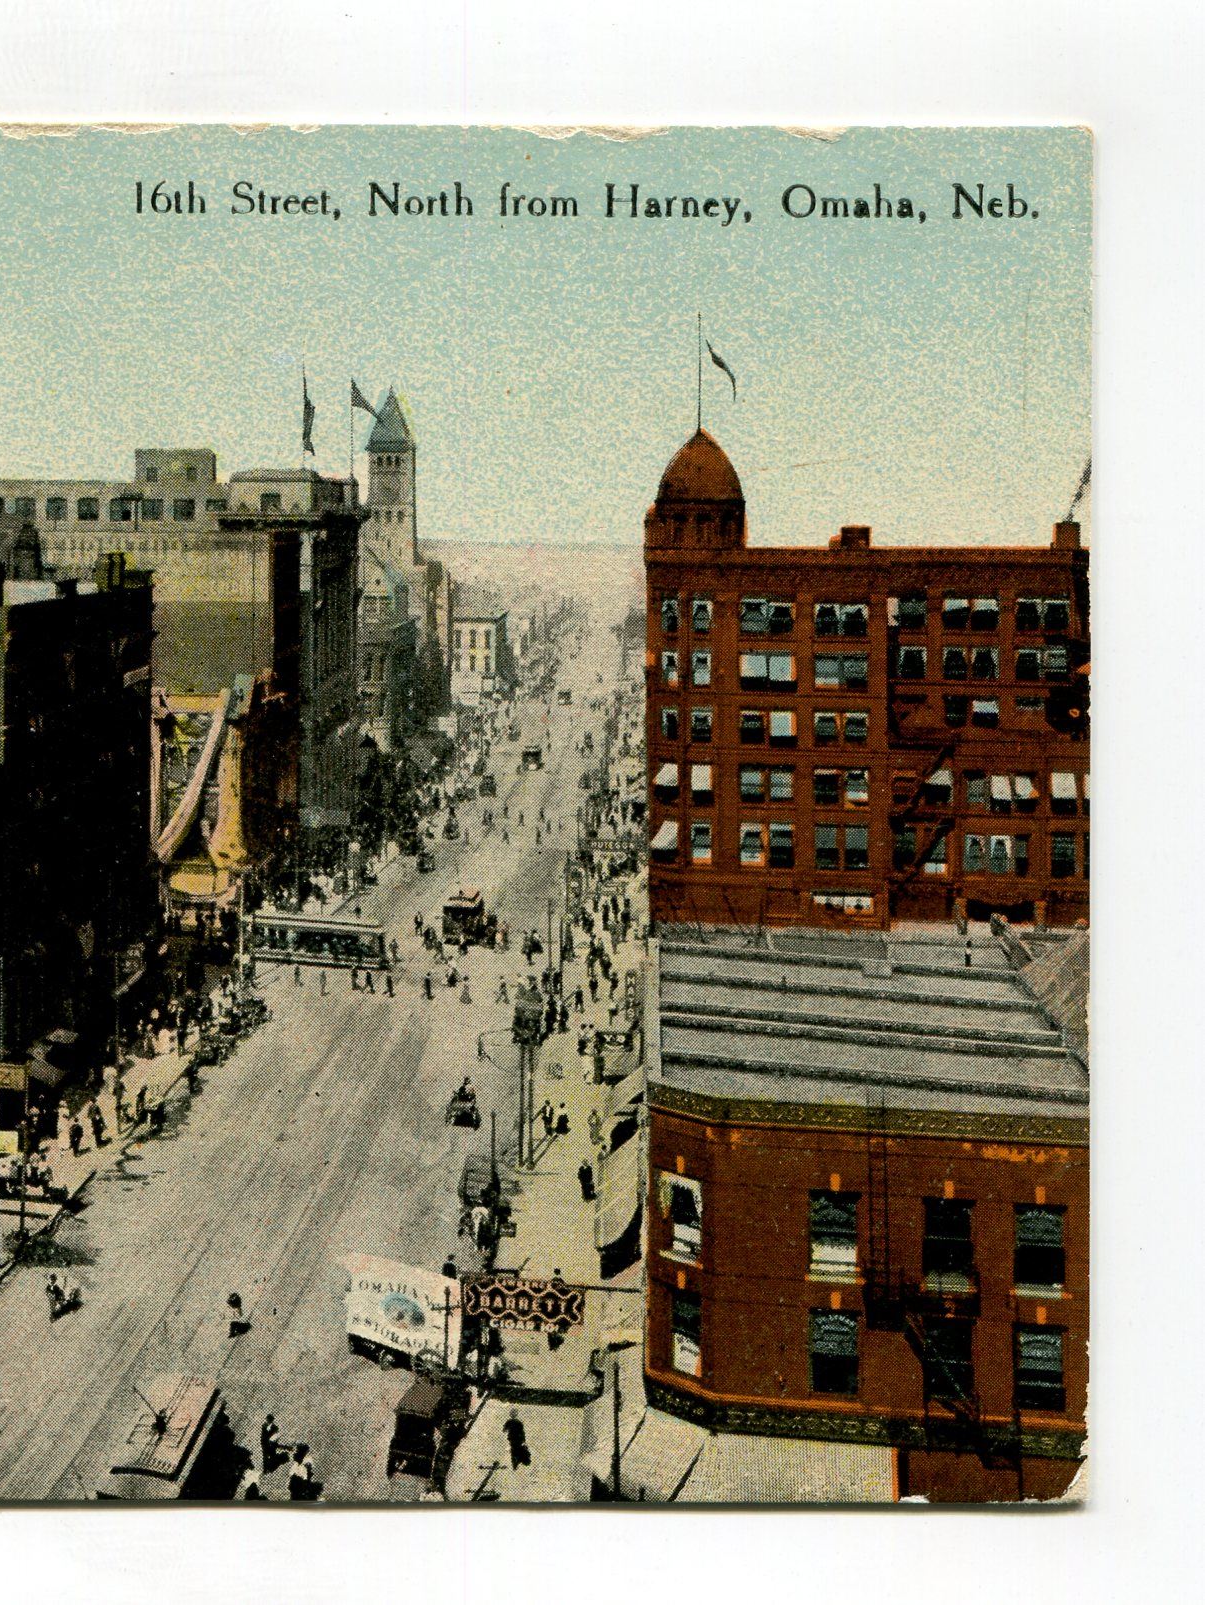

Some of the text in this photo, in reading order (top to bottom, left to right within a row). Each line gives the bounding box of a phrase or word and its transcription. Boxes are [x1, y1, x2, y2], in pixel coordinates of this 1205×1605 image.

[358, 1278, 419, 1300] OMAHA
[479, 1294, 568, 1313] BARRETT
[489, 1317, 535, 1331] CIGAR
